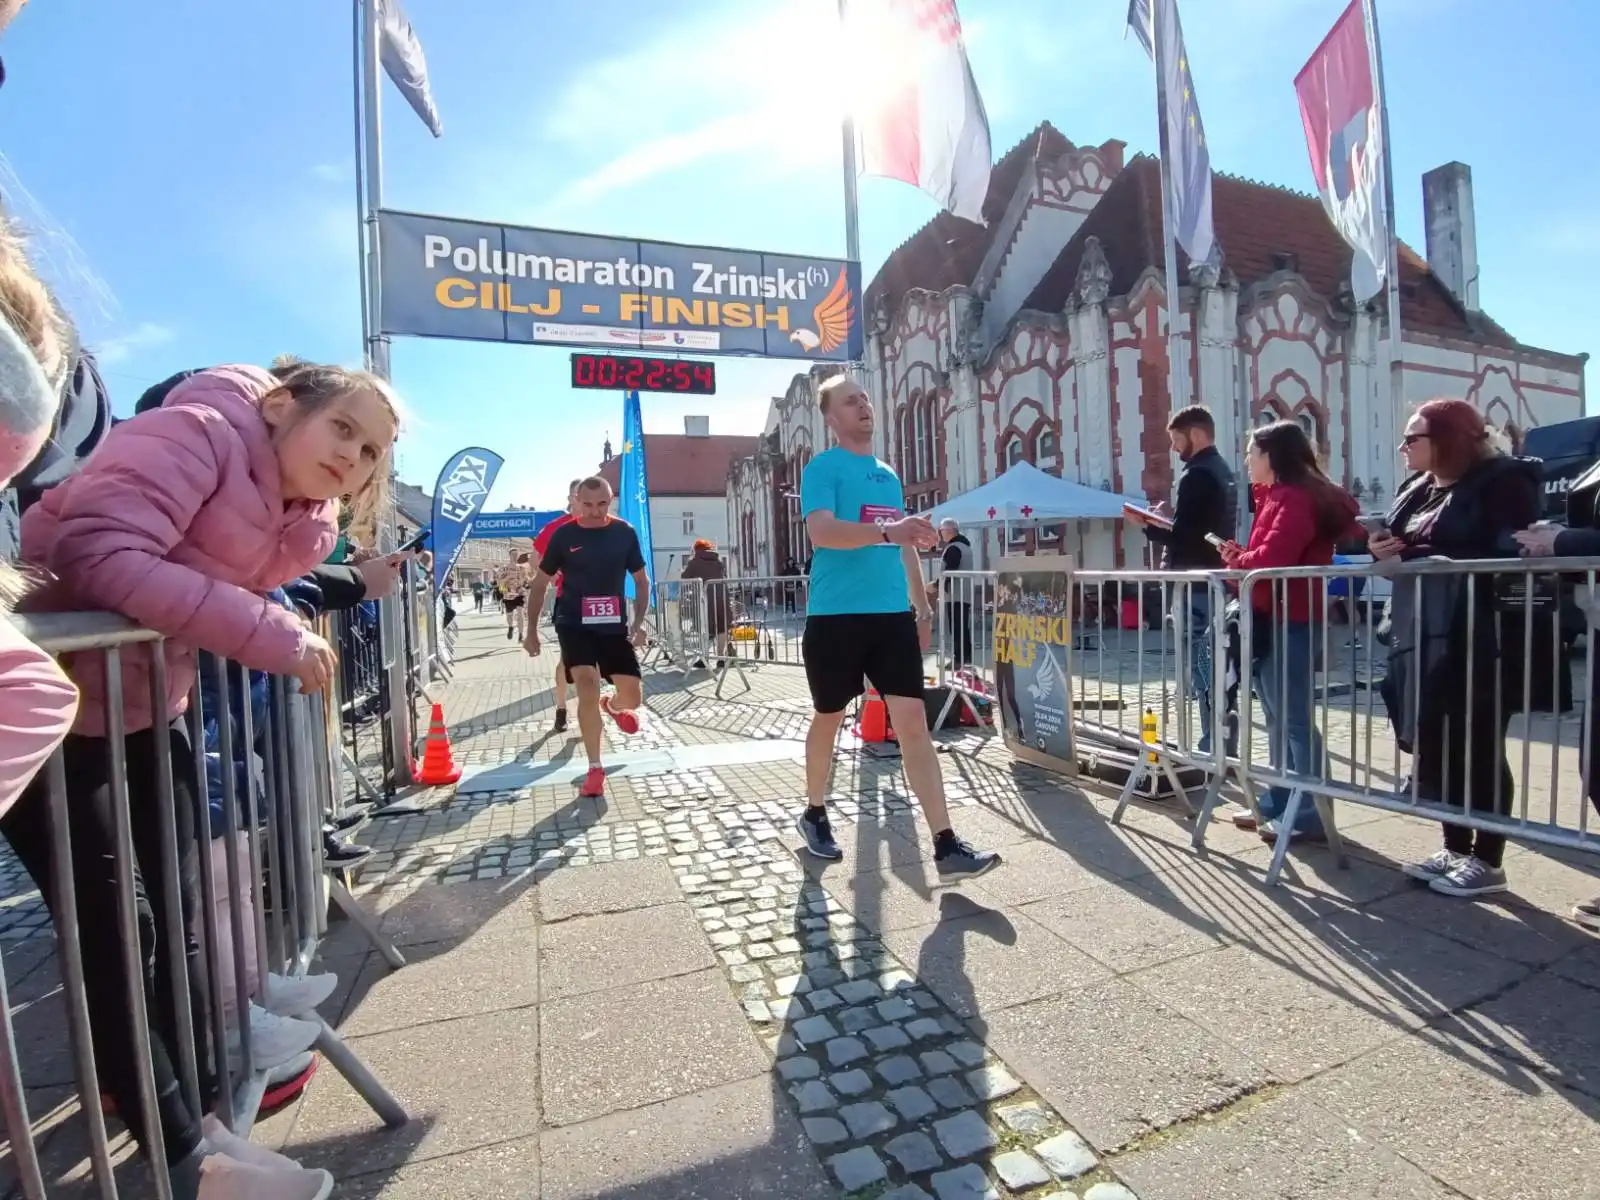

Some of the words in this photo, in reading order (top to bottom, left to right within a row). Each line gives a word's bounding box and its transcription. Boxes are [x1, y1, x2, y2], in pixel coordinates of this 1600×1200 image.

[424, 234, 675, 290] Polumaraton
[435, 277, 561, 316] CILJ
[620, 293, 789, 331] FINISH
[575, 356, 713, 391] 00:22:54
[475, 518, 531, 529] DECATHLON
[588, 603, 615, 616] 133
[994, 612, 1070, 645] ZRINSKI
[994, 636, 1037, 668] HALF
